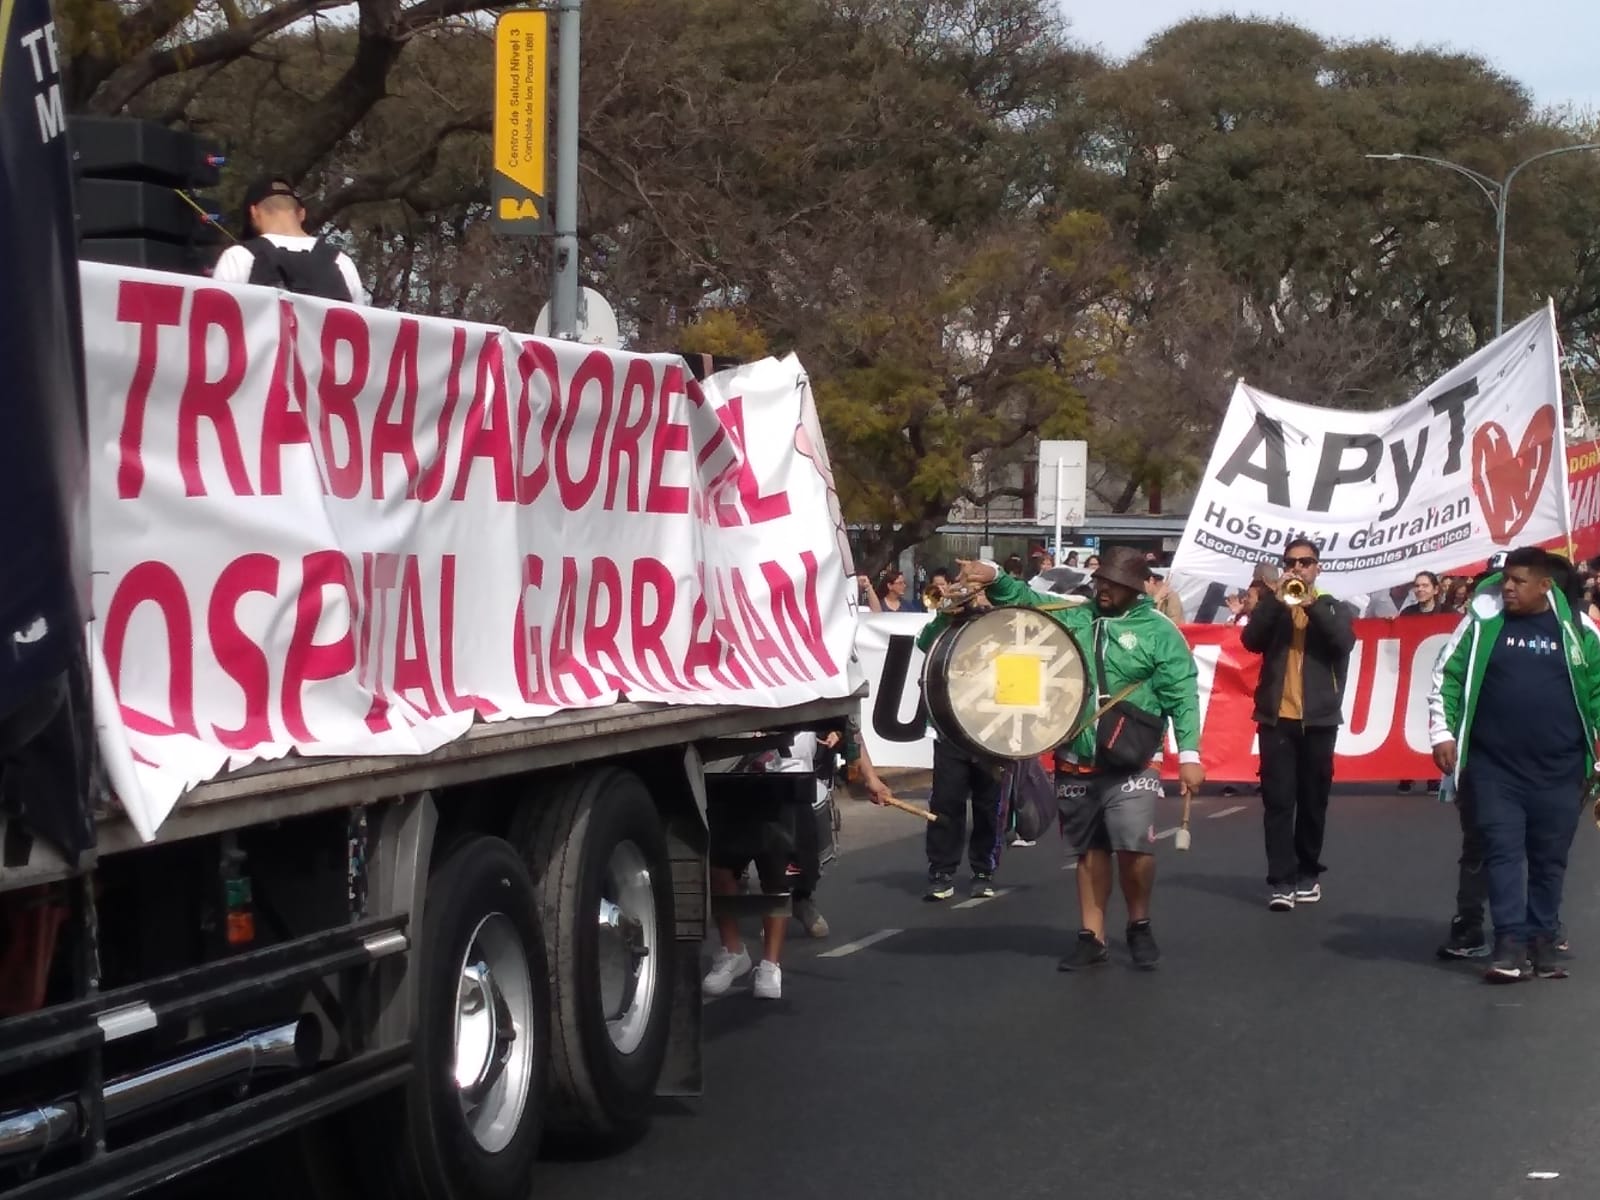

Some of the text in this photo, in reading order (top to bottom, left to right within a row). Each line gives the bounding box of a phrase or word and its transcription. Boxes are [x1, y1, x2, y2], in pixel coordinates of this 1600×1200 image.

[508, 28, 521, 168] Centro de Salud Nivel 3
[1216, 377, 1480, 523] APyT
[1196, 531, 1280, 567] Asociación
[1348, 496, 1471, 551] Garrahan
[513, 549, 840, 707] GARRAHAN
